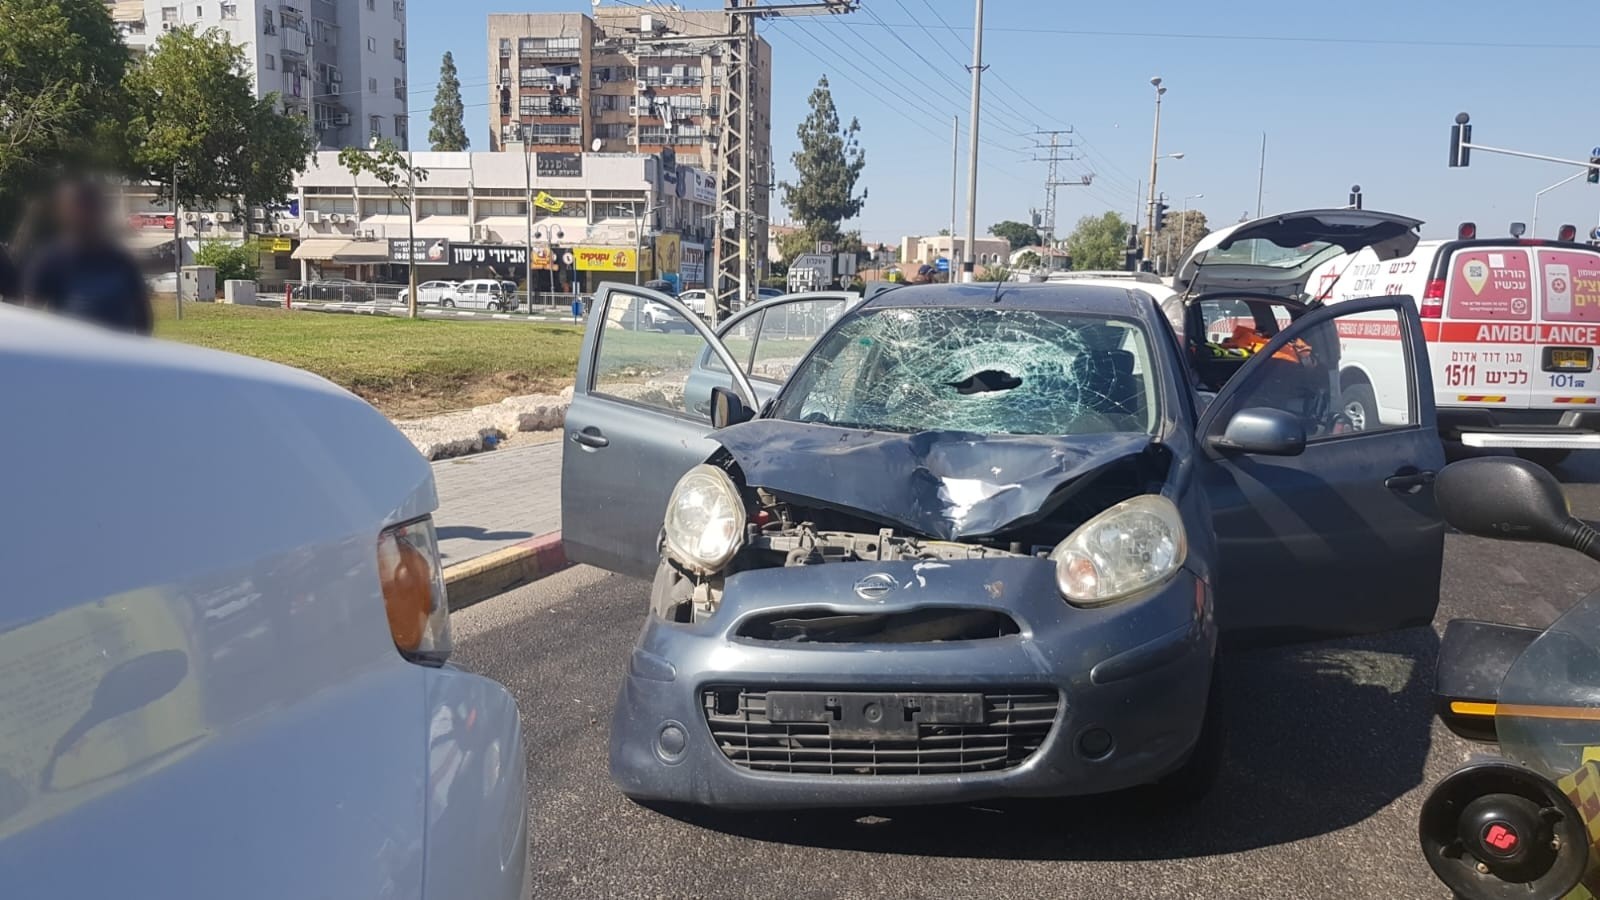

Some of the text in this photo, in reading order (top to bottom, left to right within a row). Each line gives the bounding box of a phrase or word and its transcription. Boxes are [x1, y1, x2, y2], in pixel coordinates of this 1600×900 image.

[454, 247, 485, 264] עישון
[489, 248, 526, 263] אביזרי
[1389, 261, 1417, 274] לכיש
[1493, 270, 1526, 279] הורידו
[1353, 279, 1376, 291] אדום
[1494, 281, 1526, 290] עכשיו
[1476, 325, 1598, 343] AMBULANCE
[1452, 351, 1522, 364] מגן דוד אדום
[1445, 365, 1476, 386] 1511
[1486, 369, 1528, 385] לכיש
[1549, 374, 1574, 387] 101
